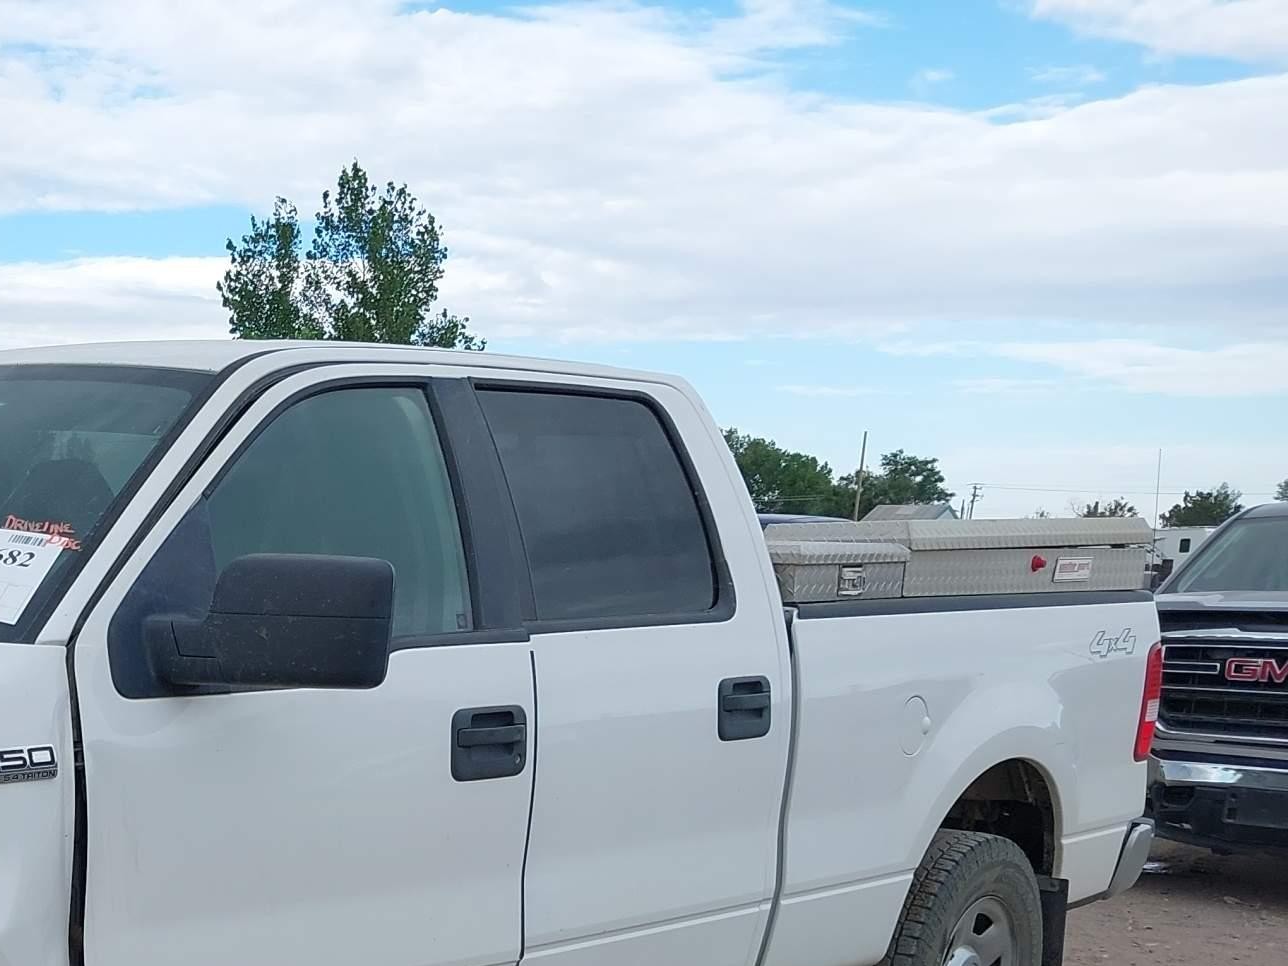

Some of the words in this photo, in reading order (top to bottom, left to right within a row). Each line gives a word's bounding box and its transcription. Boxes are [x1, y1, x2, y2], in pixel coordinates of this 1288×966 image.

[1089, 628, 1136, 657] 4x4
[1225, 657, 1288, 683] GM
[21, 769, 57, 781] TRITON
